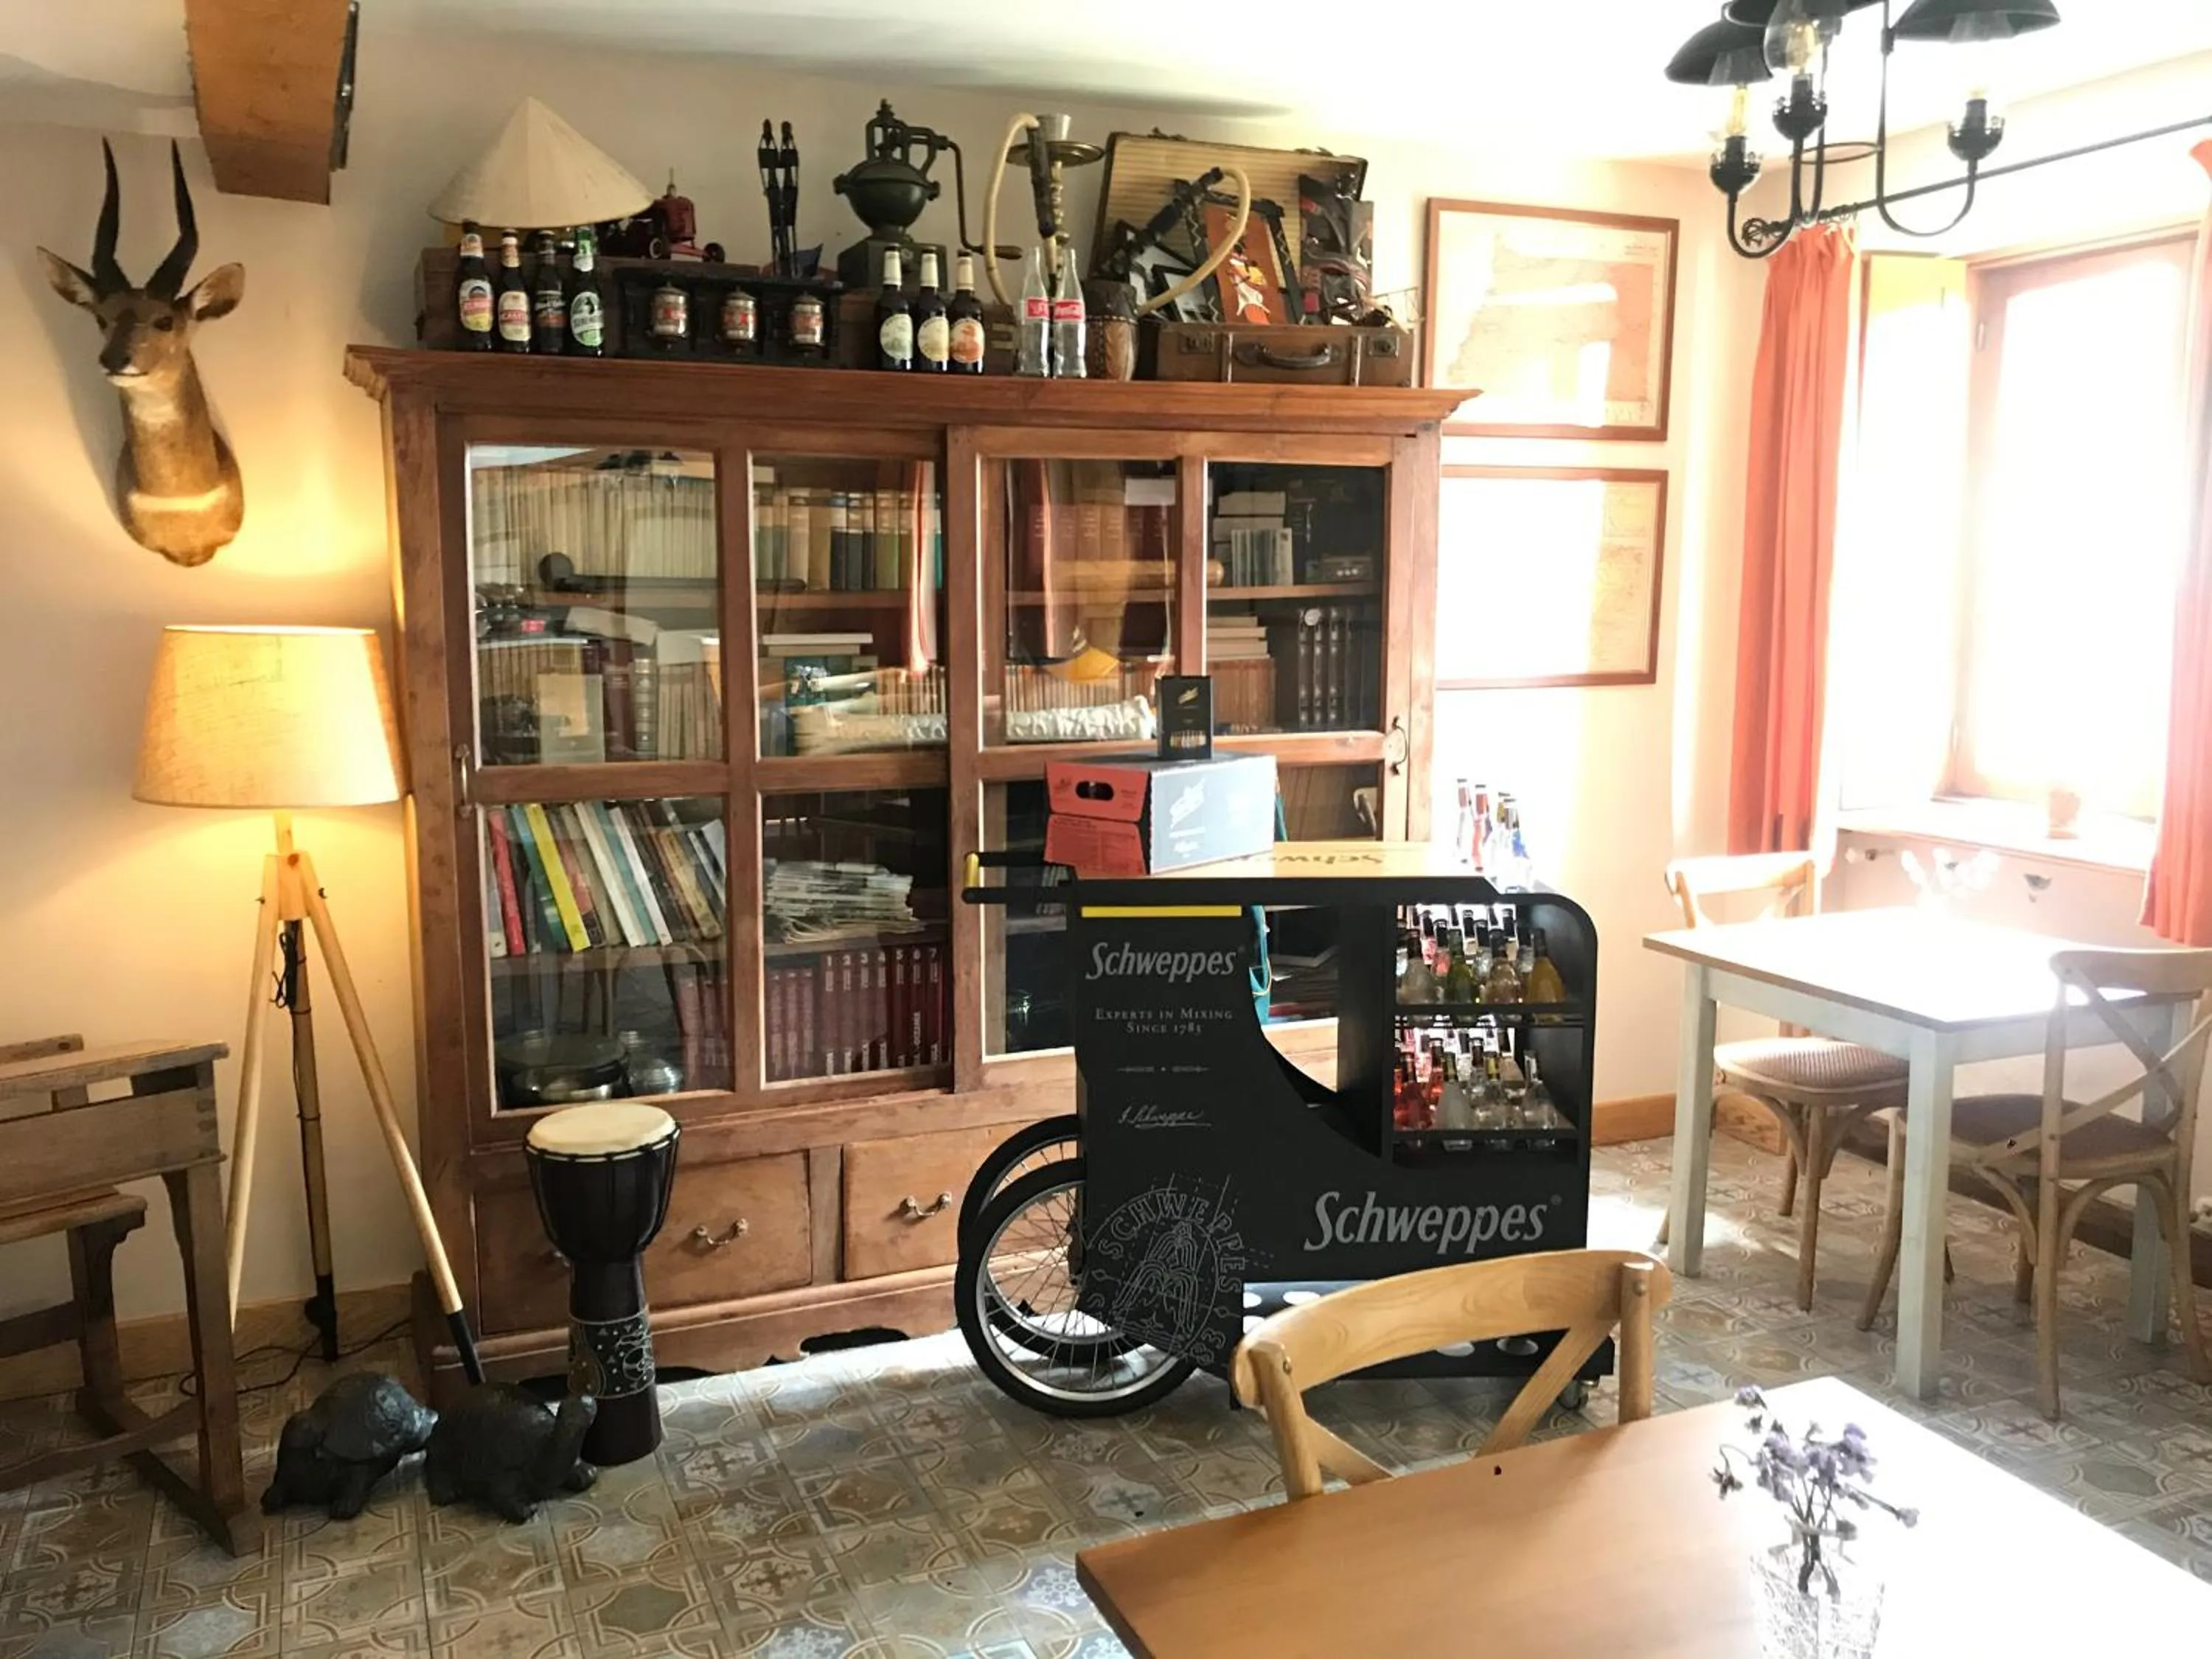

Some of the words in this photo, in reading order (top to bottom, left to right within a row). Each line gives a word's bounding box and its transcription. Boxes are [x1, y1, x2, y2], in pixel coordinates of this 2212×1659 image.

[827, 955, 832, 967] 1
[861, 953, 869, 964] 3
[1085, 942, 1237, 983] Schweppes
[1098, 1193, 1245, 1293] SCHWEPPES
[1304, 1191, 1548, 1254] Schweppes
